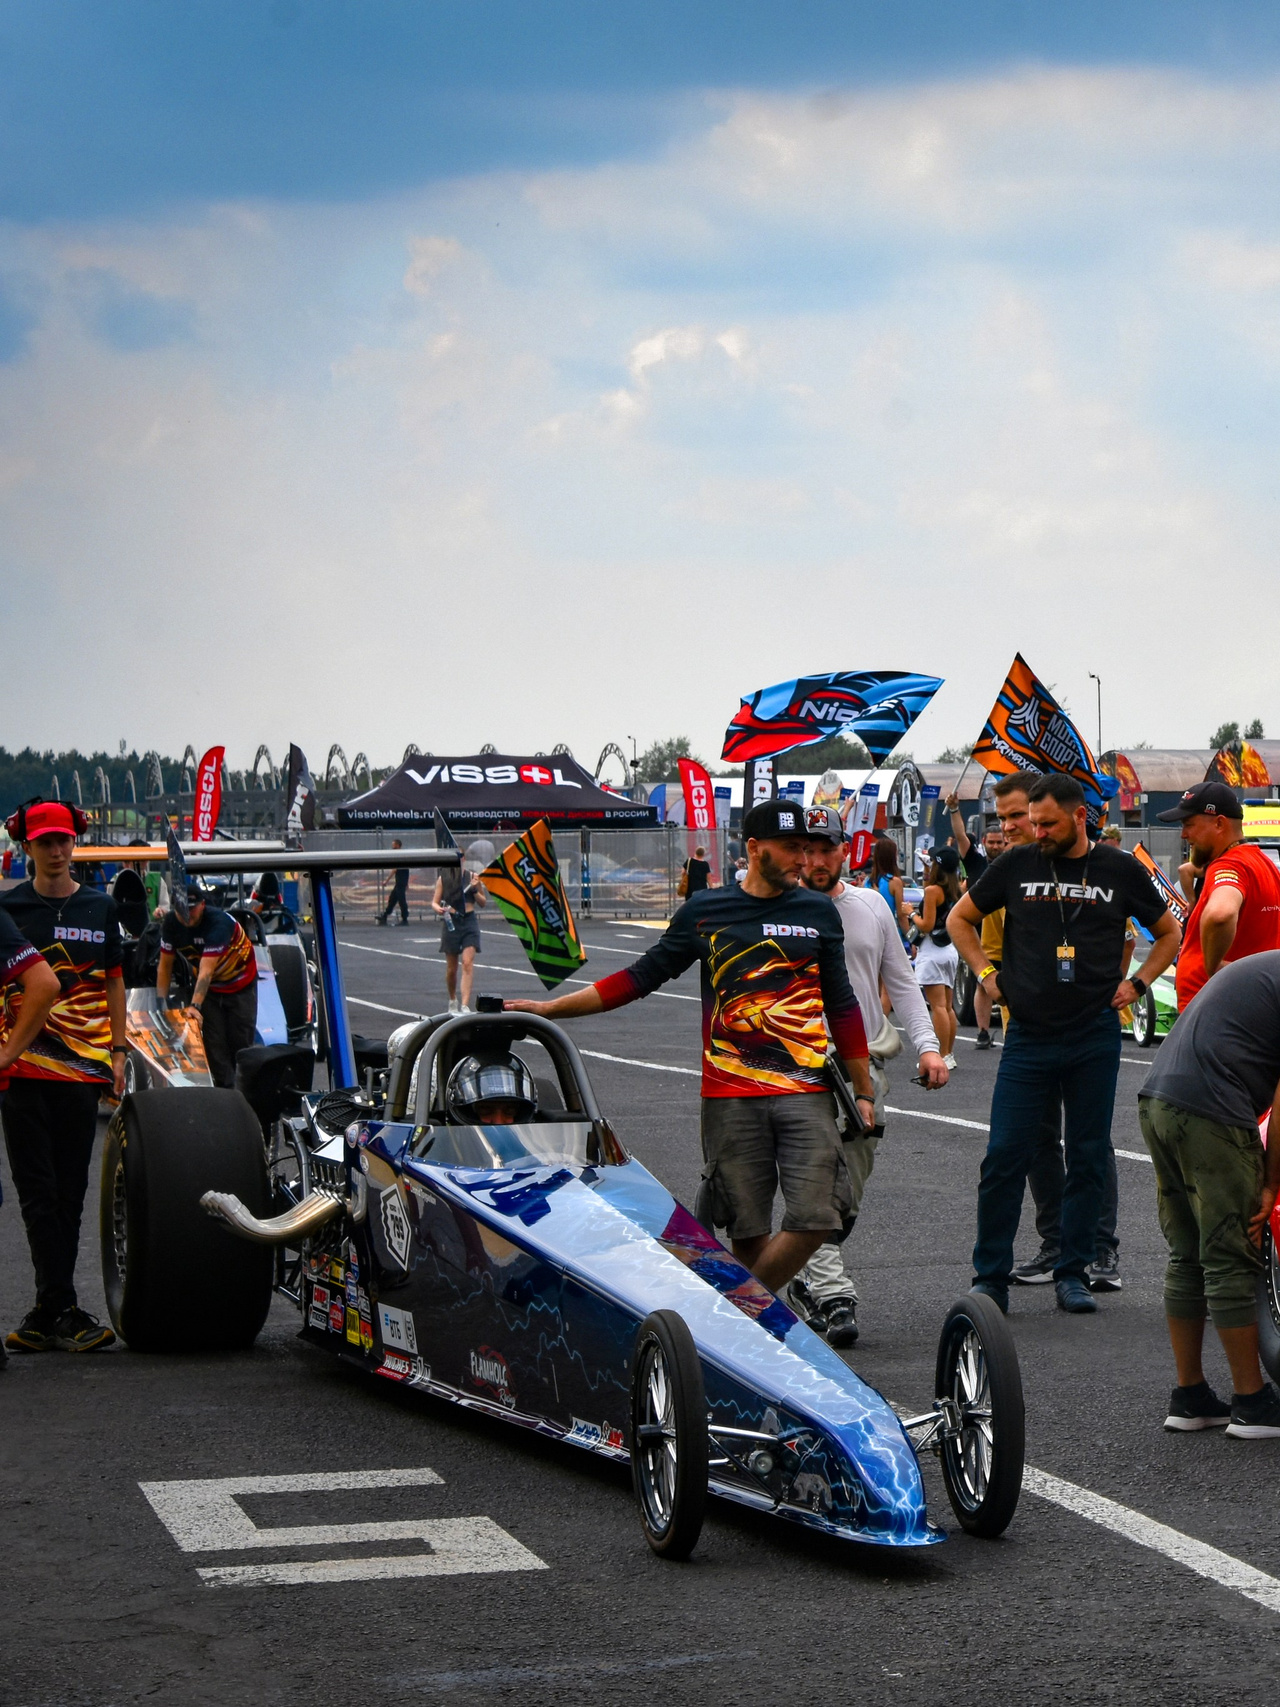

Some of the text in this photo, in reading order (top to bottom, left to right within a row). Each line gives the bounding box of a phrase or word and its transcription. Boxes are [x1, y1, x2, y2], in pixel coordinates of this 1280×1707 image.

[1039, 731, 1081, 771] СПОРТ
[347, 809, 435, 819] vissolwheels.ru
[448, 810, 520, 819] ПРОИЗВОДСТВО
[613, 810, 649, 818] РОССИИ
[54, 926, 106, 943] RDRC
[762, 923, 820, 939] RDRC
